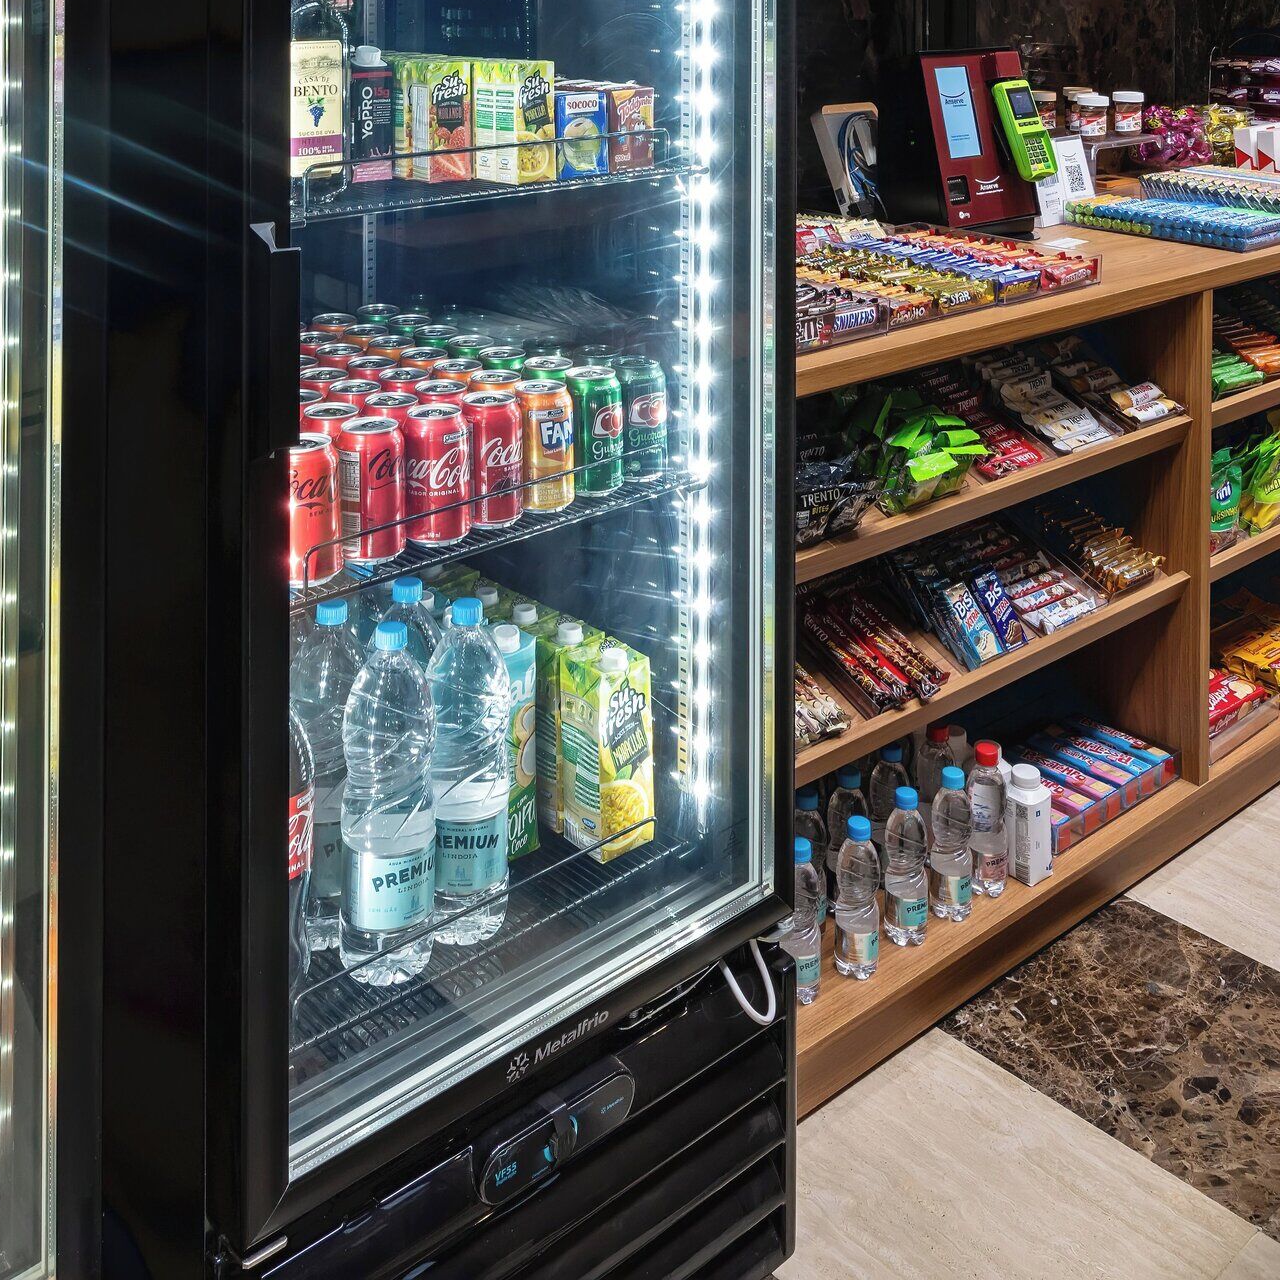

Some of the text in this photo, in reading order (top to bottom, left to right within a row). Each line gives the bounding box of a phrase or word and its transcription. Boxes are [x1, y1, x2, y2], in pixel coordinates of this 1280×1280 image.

[293, 84, 338, 97] BENTO
[432, 82, 468, 104] fresh
[518, 82, 550, 108] fresh
[361, 86, 373, 140] YoPRO
[566, 99, 598, 111] SOCOCO
[619, 95, 653, 122] Toddynho
[298, 147, 321, 156] 100%
[833, 310, 875, 332] SNICKERS
[540, 420, 574, 445] FAN
[429, 488, 459, 497] ORIGINAL
[801, 488, 840, 508] TRENTO
[600, 691, 646, 746] fresh
[372, 854, 435, 893] PREMIU
[533, 1009, 610, 1065] Metalfrio
[494, 1161, 518, 1182] VF55
